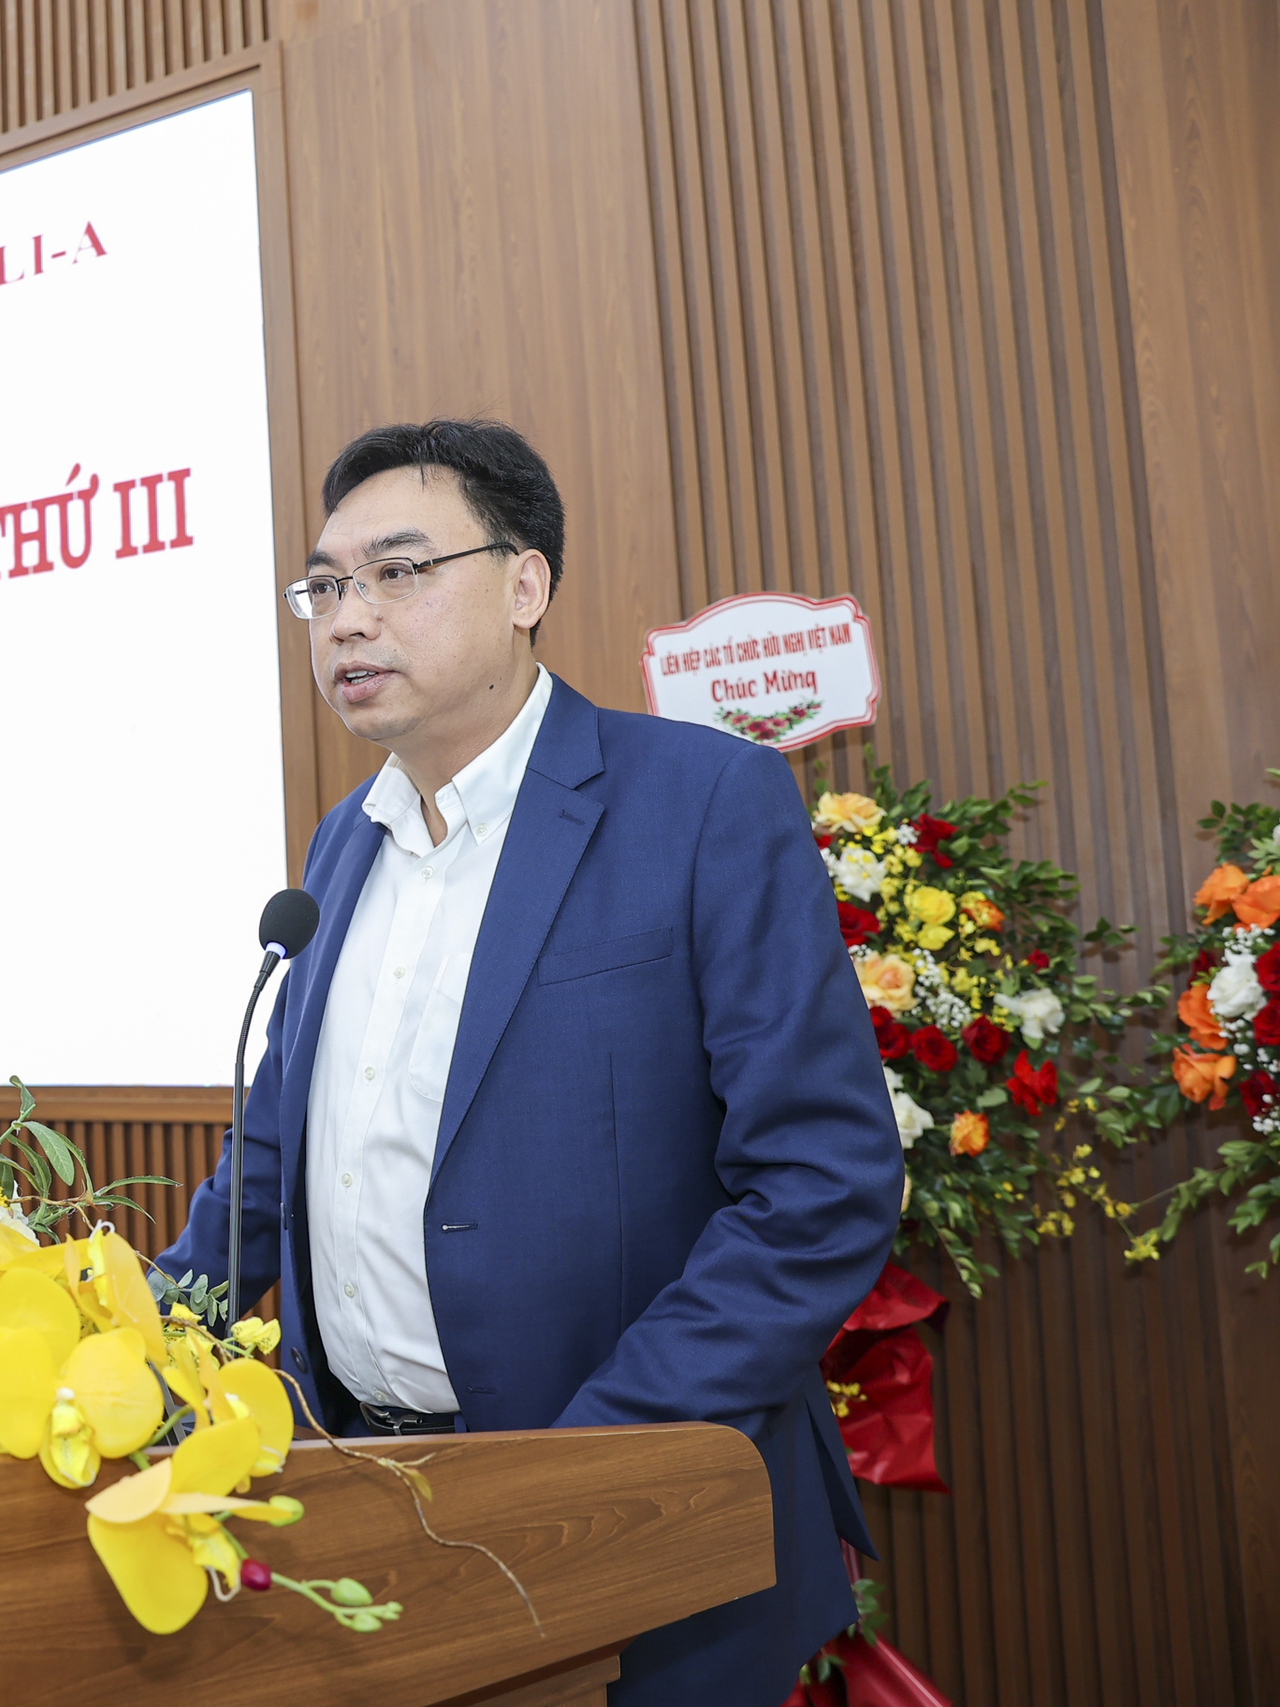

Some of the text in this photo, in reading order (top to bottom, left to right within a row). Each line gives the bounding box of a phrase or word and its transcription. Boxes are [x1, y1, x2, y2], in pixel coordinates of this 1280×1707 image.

[113, 467, 195, 560] III
[807, 623, 827, 654] VIỆT
[828, 622, 852, 646] NAM
[711, 669, 819, 702] Chúc Mừng
